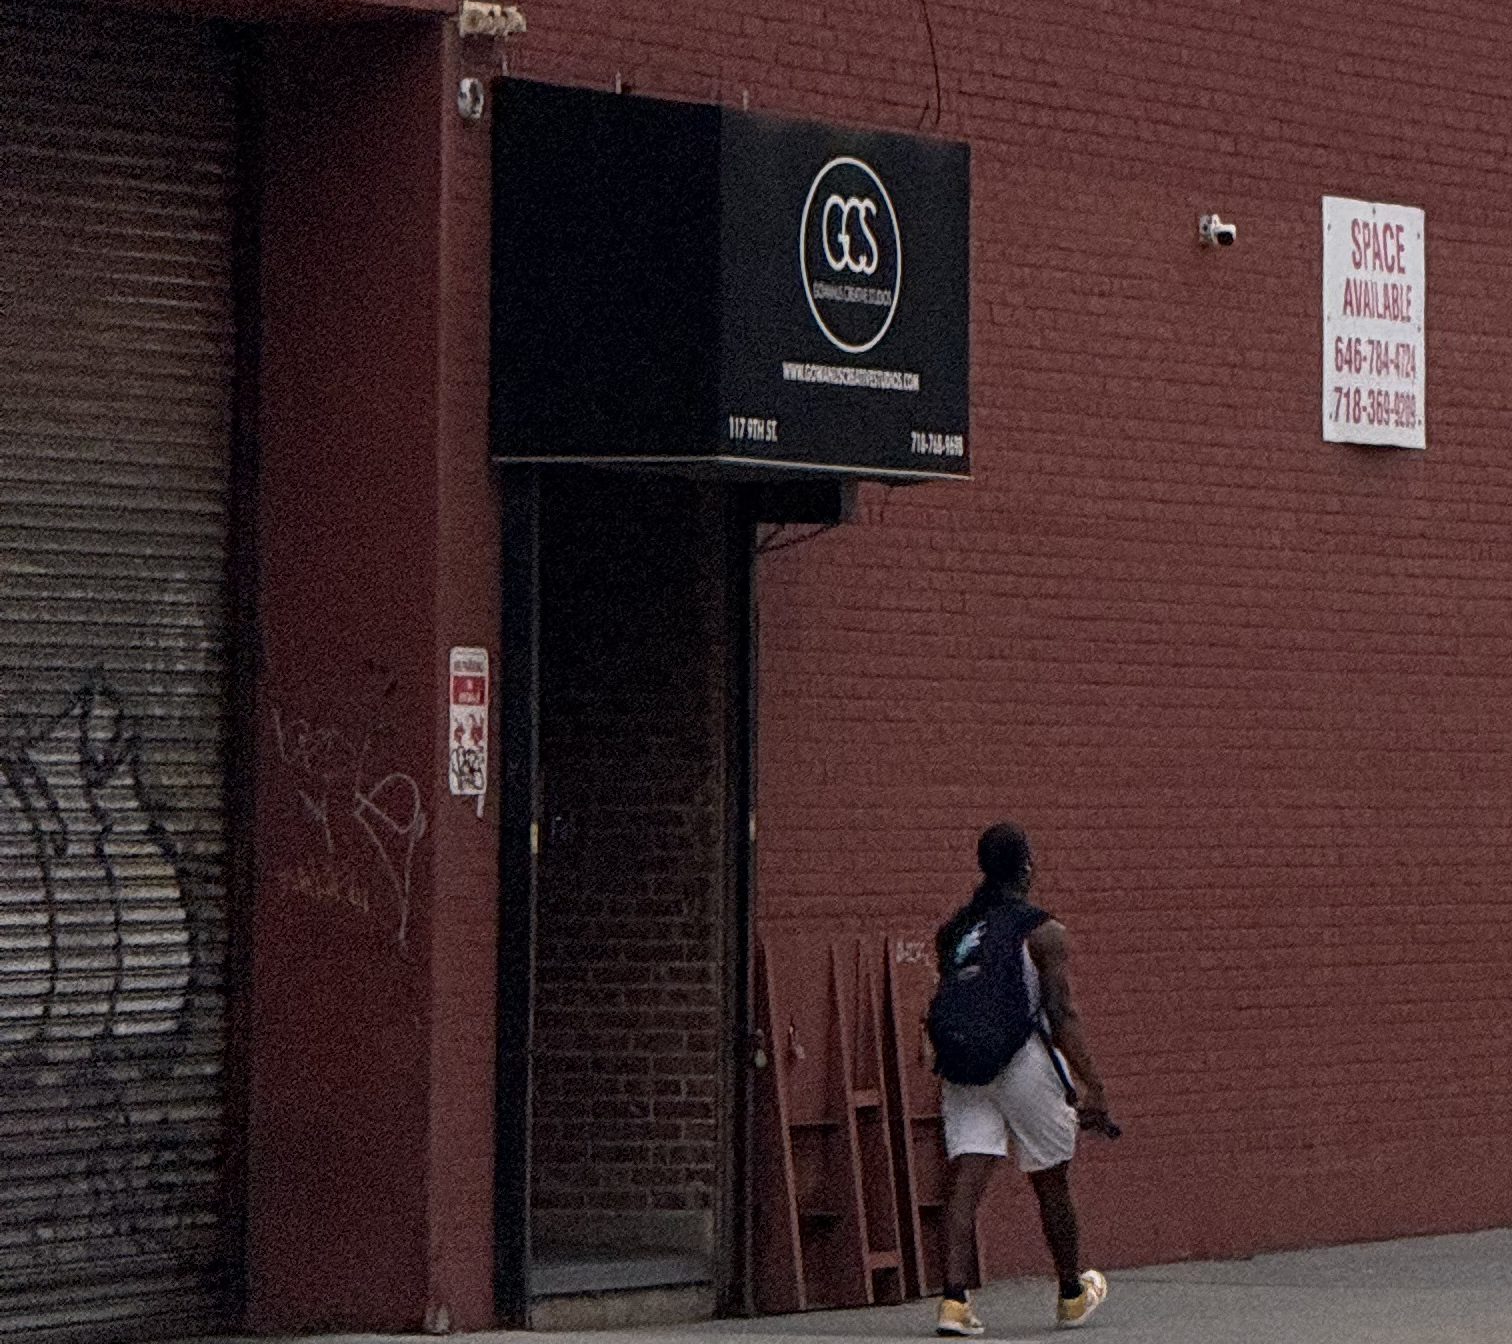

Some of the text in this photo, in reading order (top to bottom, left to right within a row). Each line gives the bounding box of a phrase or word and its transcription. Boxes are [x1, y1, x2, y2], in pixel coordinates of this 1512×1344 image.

[822, 193, 878, 275] GCS
[1350, 217, 1406, 274] SPACE
[1343, 277, 1412, 323] AVAILABLE
[729, 414, 746, 440] 117
[747, 417, 765, 442] 9TH
